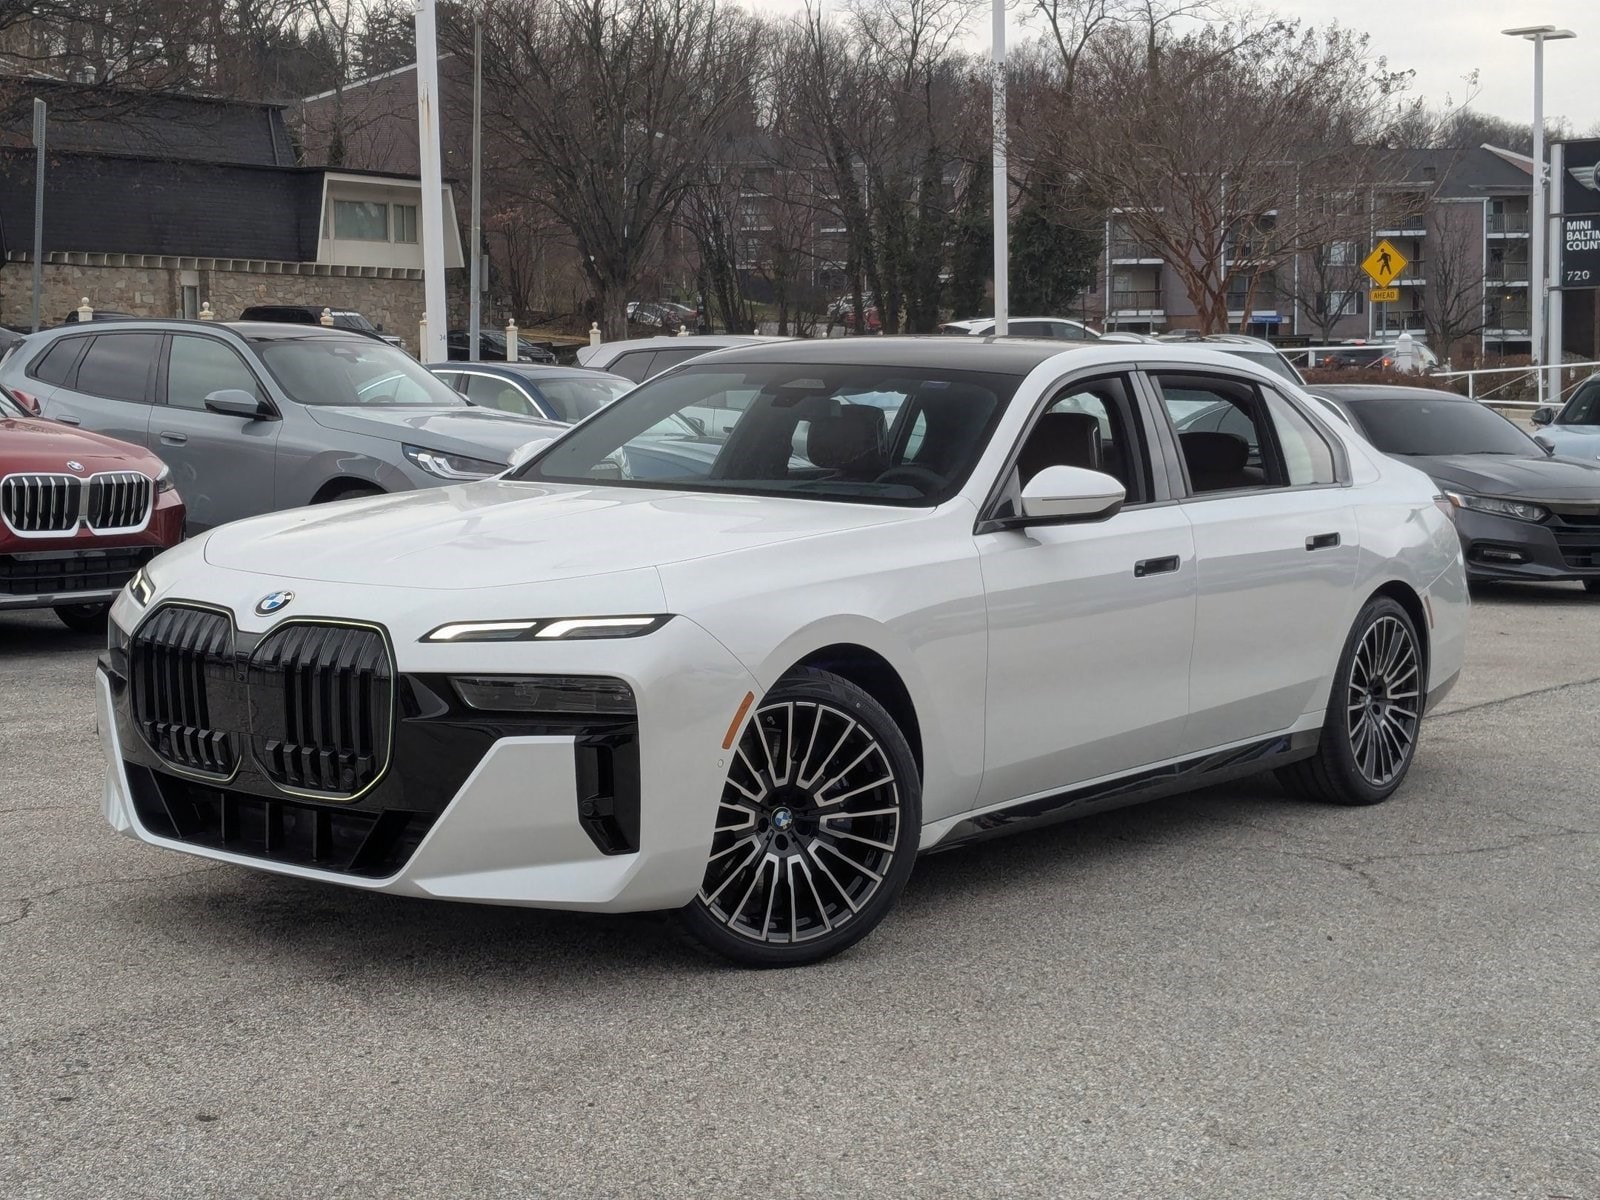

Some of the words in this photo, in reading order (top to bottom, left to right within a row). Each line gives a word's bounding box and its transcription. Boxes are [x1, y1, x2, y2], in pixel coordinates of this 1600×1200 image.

[1566, 220, 1591, 231] MINI
[1566, 270, 1590, 281] 720
[1373, 291, 1395, 299] AHEAD
